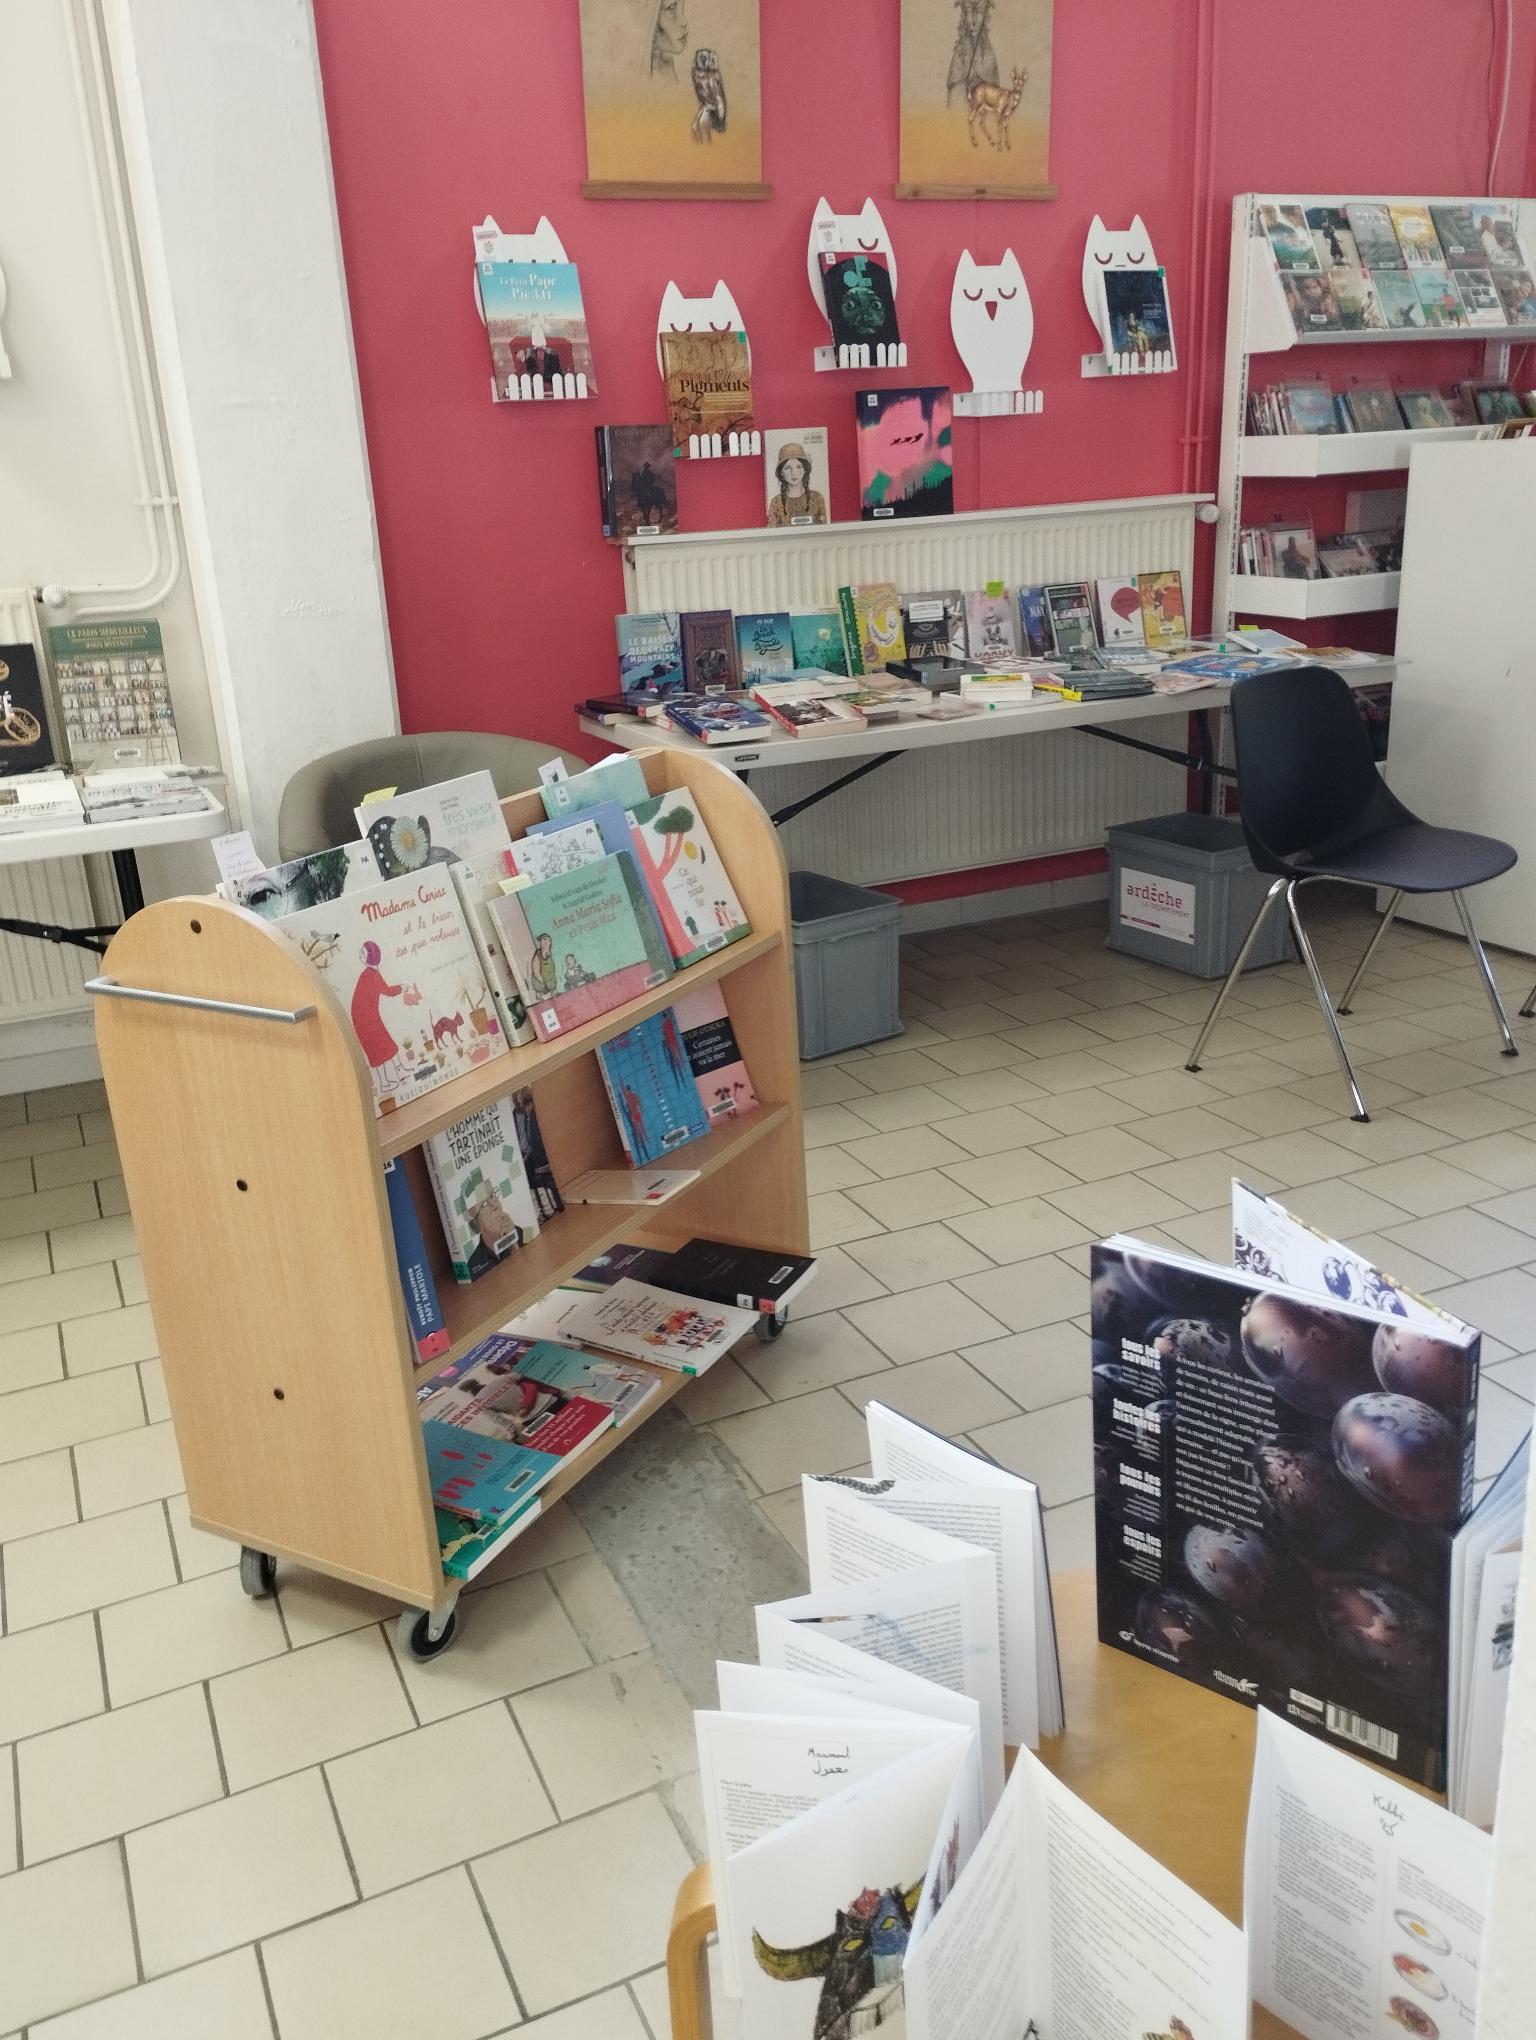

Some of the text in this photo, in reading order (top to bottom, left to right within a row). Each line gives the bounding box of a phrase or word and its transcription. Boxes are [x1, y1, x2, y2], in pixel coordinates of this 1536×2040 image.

[529, 274, 556, 289] Pape
[680, 380, 750, 397] Pigments
[361, 884, 447, 922] Madame Cerise
[1126, 883, 1183, 908] ardèche
[575, 902, 602, 919] Maria
[403, 920, 413, 935] et
[396, 945, 408, 958] des
[429, 928, 460, 943] voleuses
[691, 1032, 722, 1050] Certaines
[446, 1104, 498, 1142] L'HOMME QUI
[449, 1116, 500, 1158] TARTINAIT
[454, 1150, 472, 1170] UNE
[414, 1263, 434, 1323] PAPI MARIOLE
[1121, 1349, 1161, 1370] savoirs
[1122, 1338, 1160, 1360] tous les
[1112, 1398, 1160, 1424] toutes les
[1112, 1408, 1161, 1434] histoires
[1120, 1462, 1161, 1487] tous les
[1120, 1474, 1161, 1498] pouvoirs
[1124, 1524, 1161, 1548] tous les
[1124, 1535, 1161, 1558] espoirs
